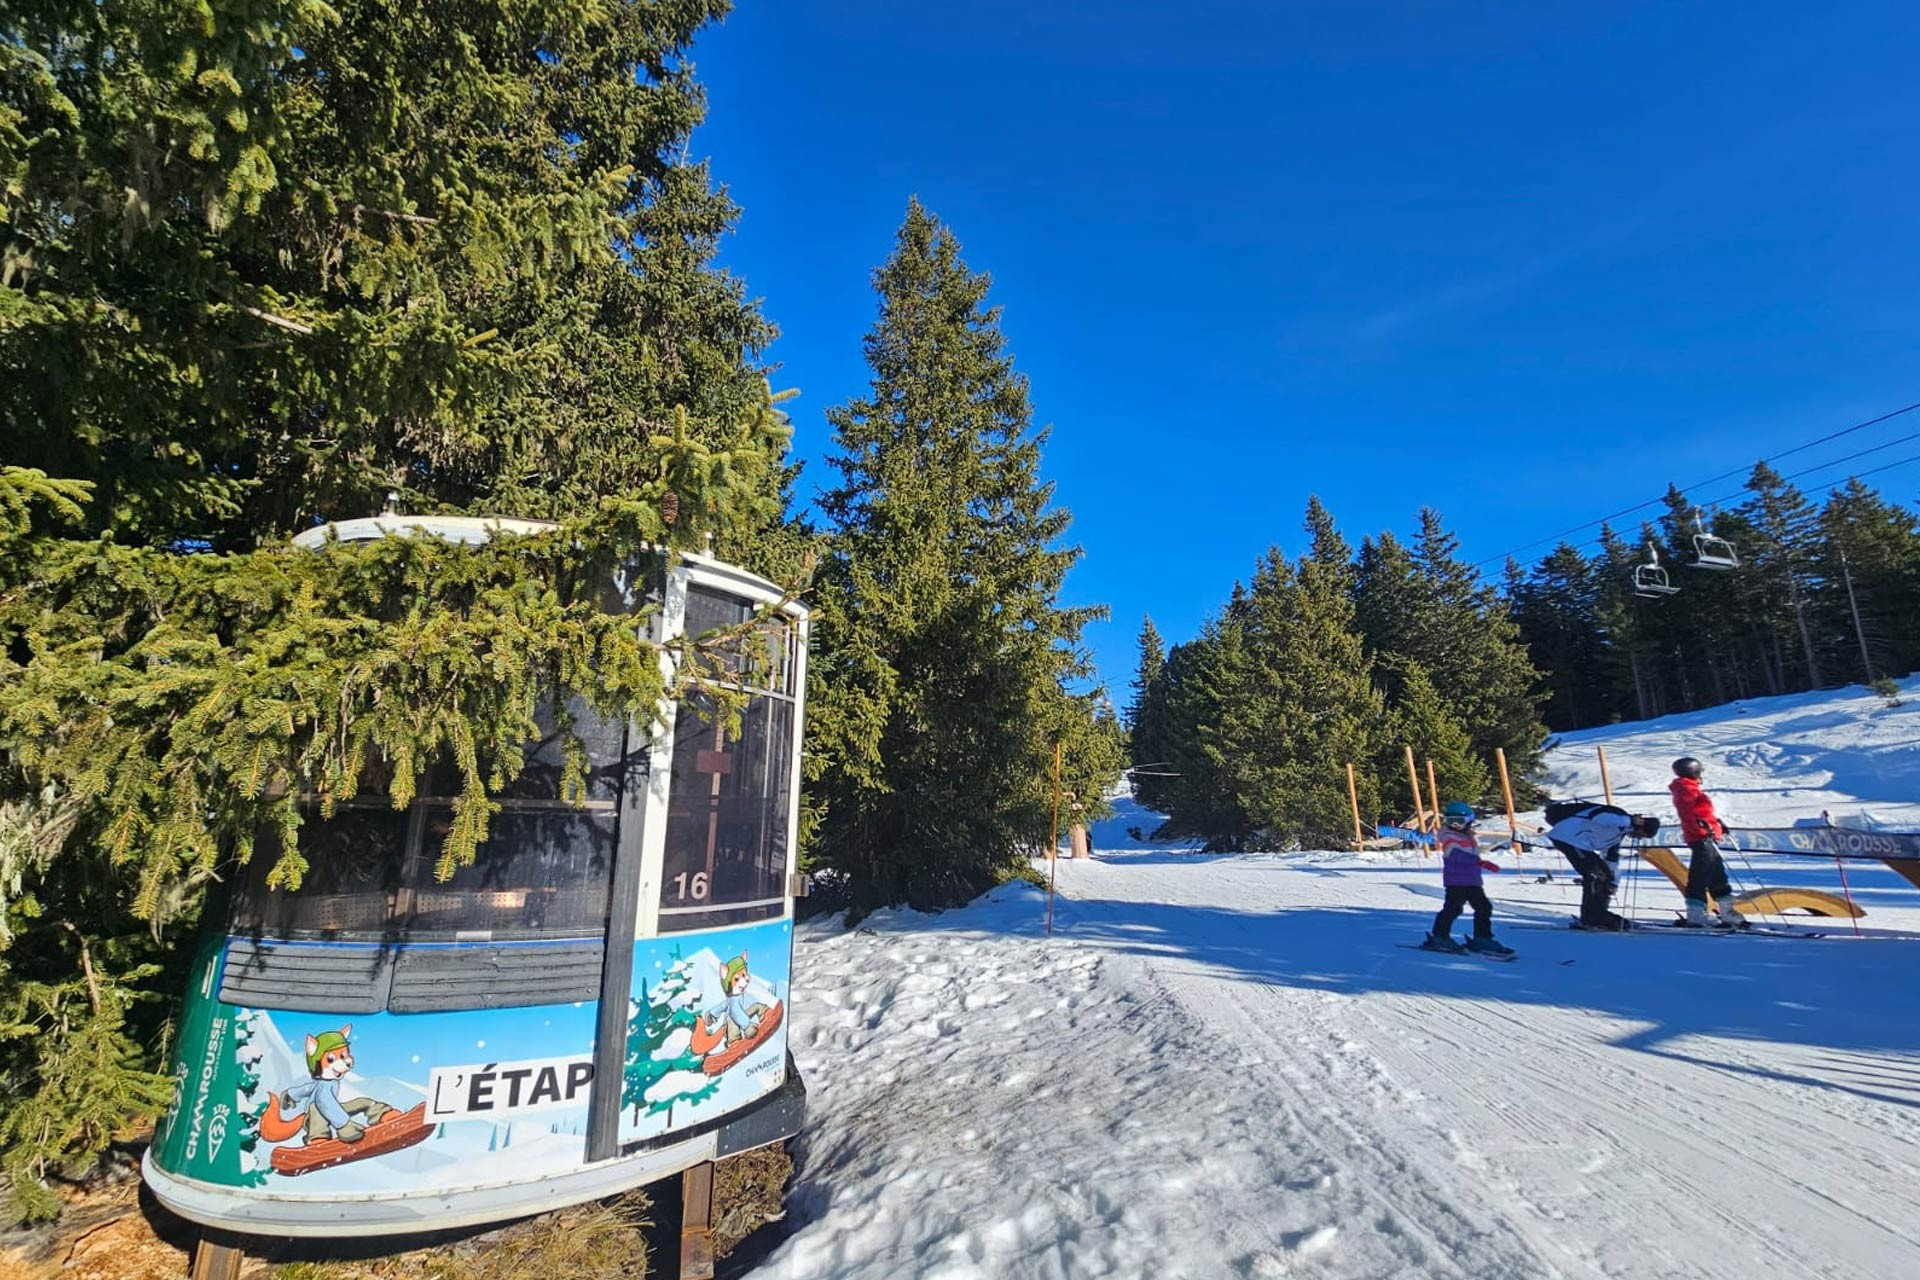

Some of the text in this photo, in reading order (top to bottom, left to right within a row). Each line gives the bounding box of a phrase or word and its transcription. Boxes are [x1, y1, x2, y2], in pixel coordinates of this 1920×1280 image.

[1788, 830, 1902, 853] CHAMROUSSE
[674, 871, 708, 900] 16
[186, 1017, 223, 1160] CHAMROUSSE
